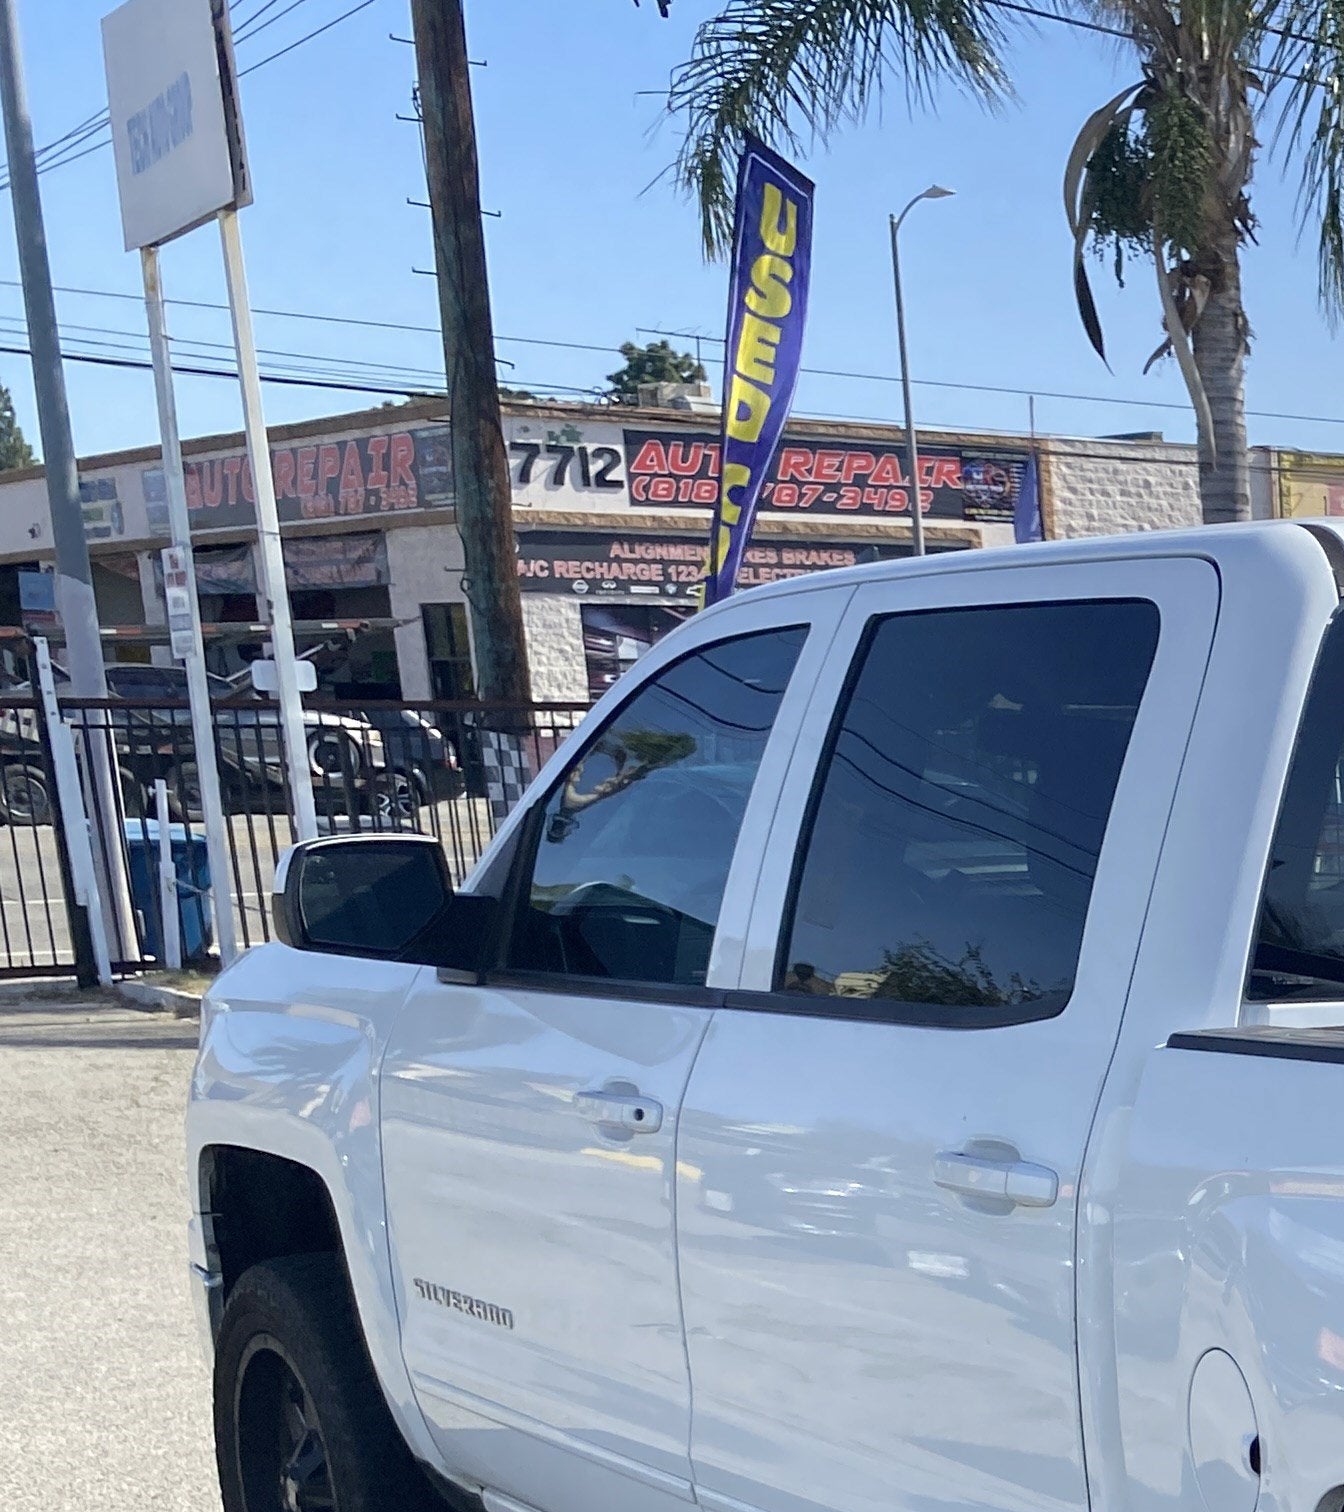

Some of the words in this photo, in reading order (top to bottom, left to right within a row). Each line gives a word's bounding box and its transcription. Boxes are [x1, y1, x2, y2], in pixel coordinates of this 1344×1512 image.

[726, 181, 797, 443] USED
[274, 432, 415, 500] REPAIR
[509, 442, 625, 489] 7712
[629, 438, 719, 477] AUT
[631, 475, 719, 504] (818
[553, 559, 665, 582] RECHARGE
[609, 540, 712, 561] ALIGNMEN
[781, 548, 856, 566] BRAKES
[412, 1277, 514, 1330] SILVERADO
